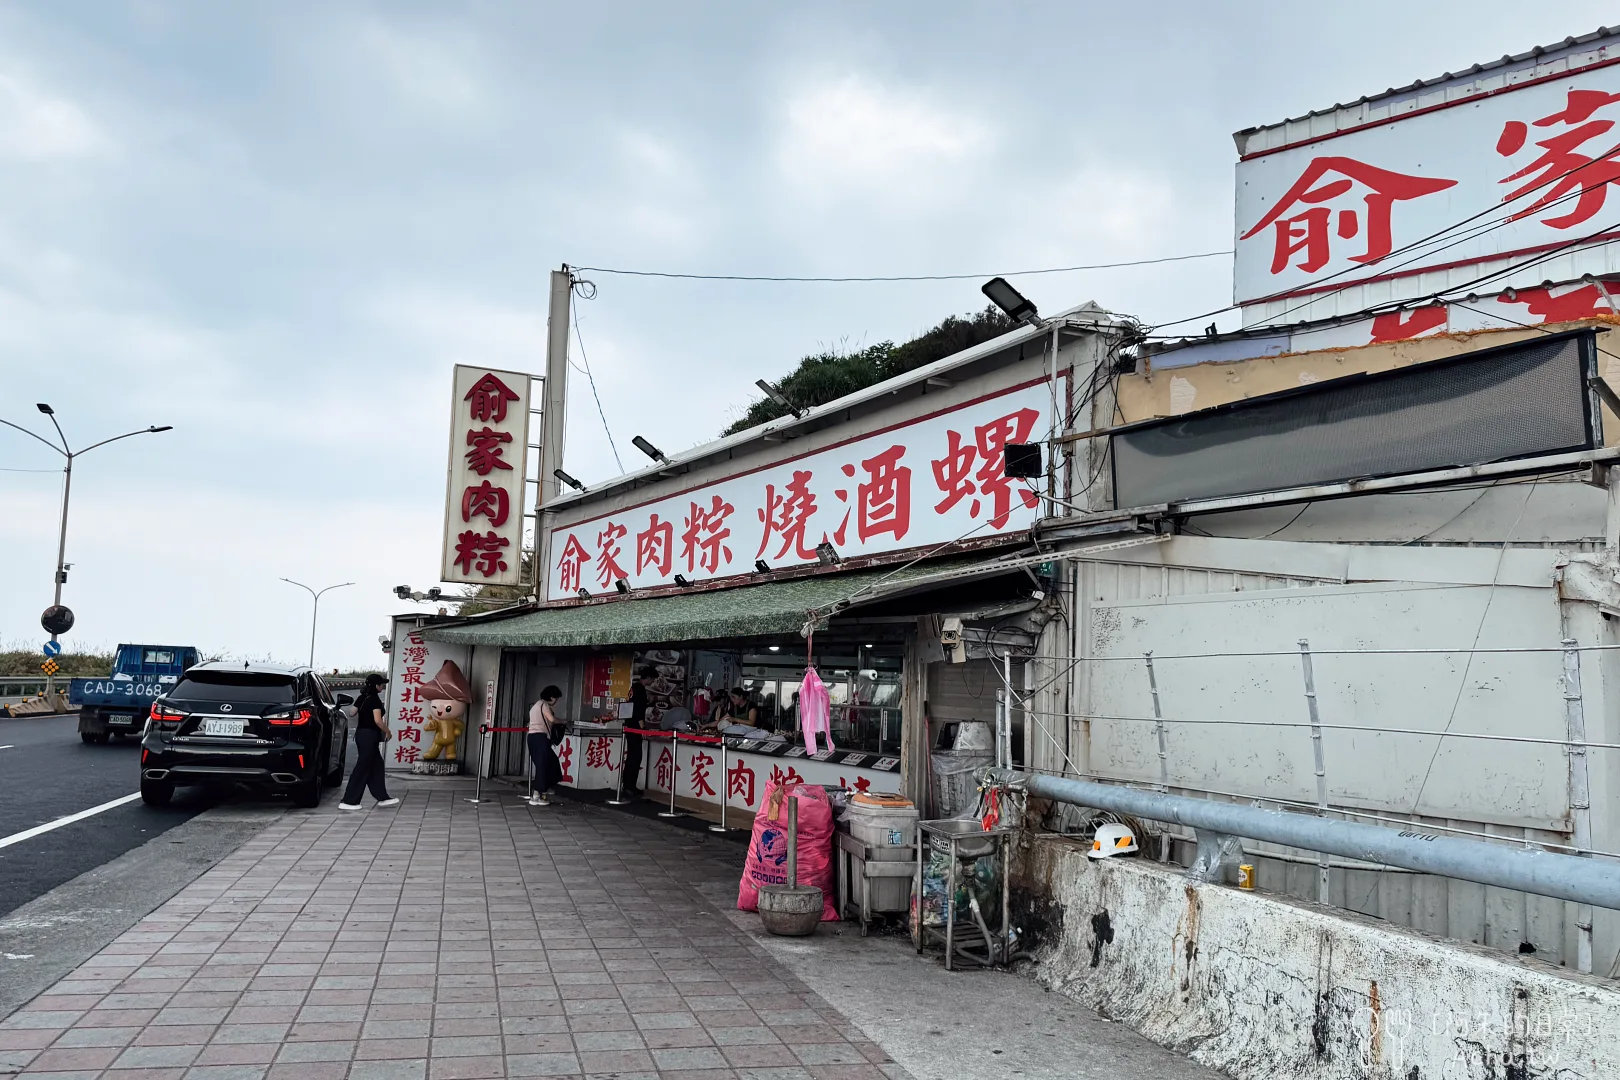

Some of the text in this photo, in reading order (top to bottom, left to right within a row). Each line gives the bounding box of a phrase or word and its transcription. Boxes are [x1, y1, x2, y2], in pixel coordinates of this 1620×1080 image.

[453, 372, 520, 578] 俞家肉粽
[84, 681, 163, 697] CAD-3068
